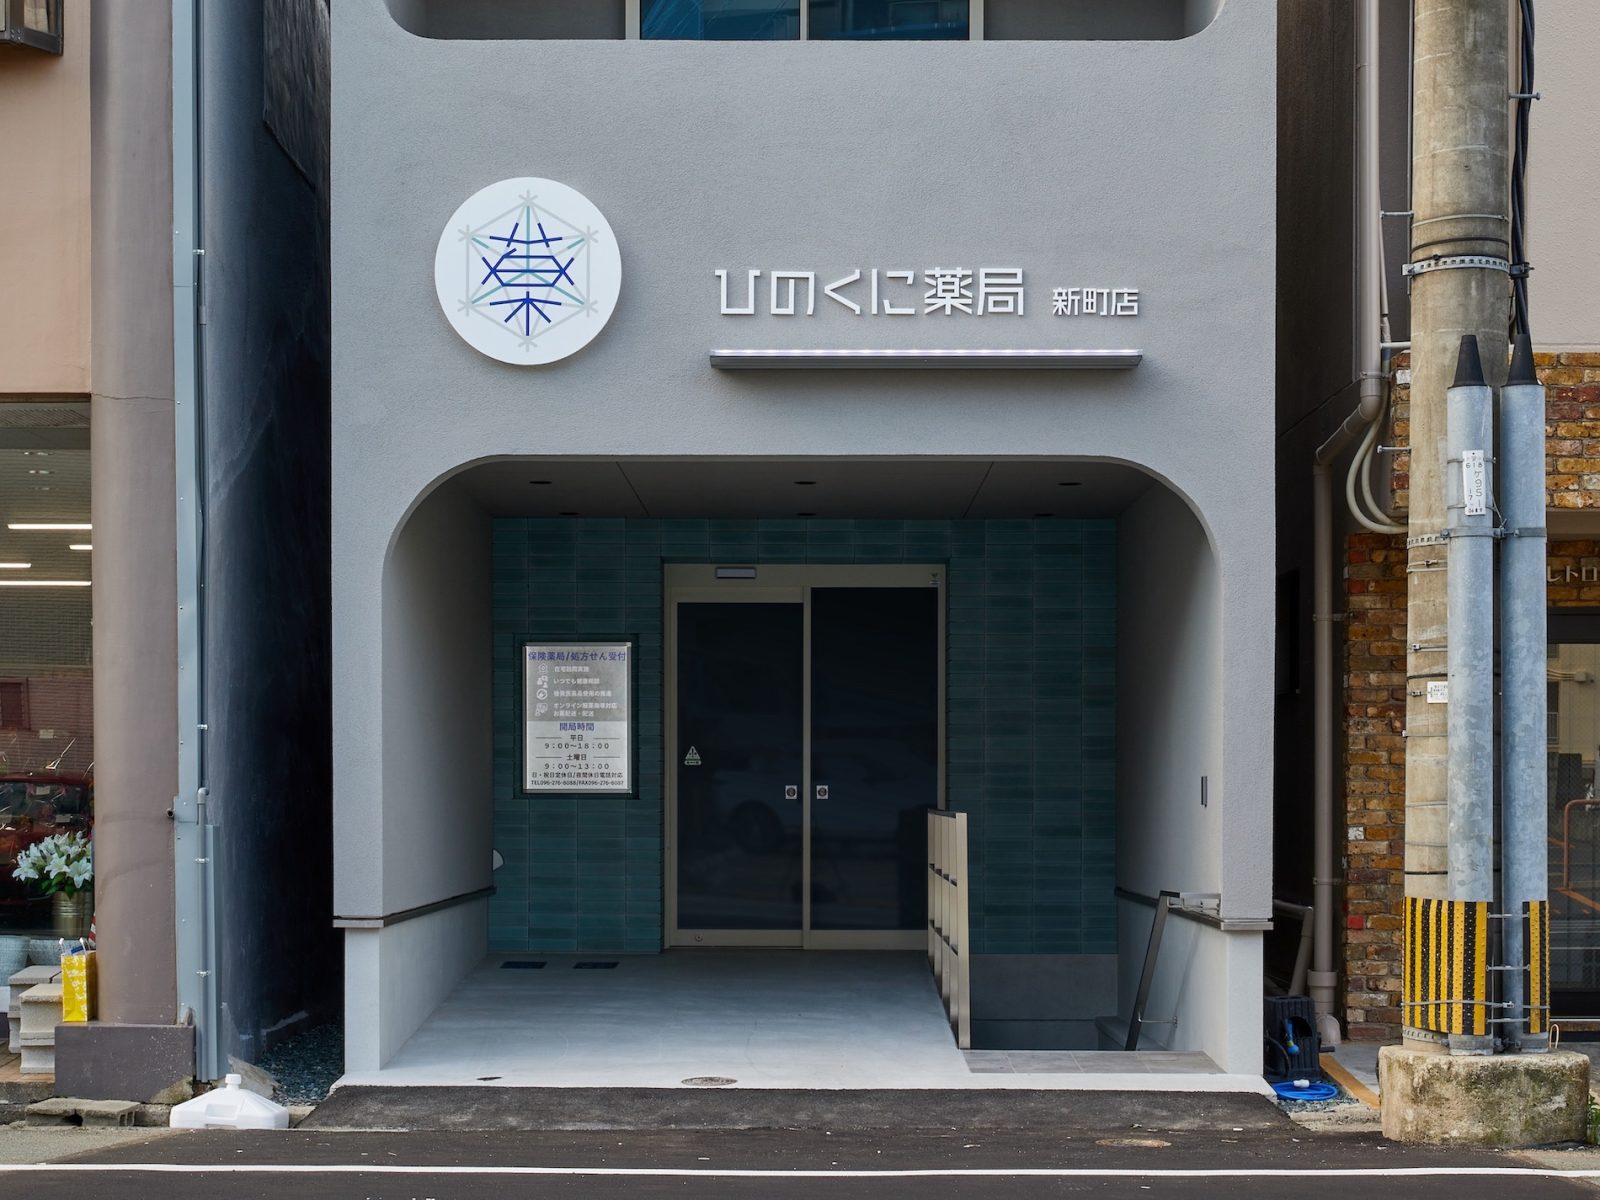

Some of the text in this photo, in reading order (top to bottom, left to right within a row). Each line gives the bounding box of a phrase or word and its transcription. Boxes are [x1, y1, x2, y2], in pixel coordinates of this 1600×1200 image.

[714, 267, 1139, 316] ひのくに薬局 新町店
[1547, 565, 1598, 583] レトロ
[528, 651, 626, 661] 保険薬局/処方せん受付
[559, 722, 595, 732] 開局時間
[570, 734, 584, 742] 平日
[567, 753, 587, 761] 土曜日
